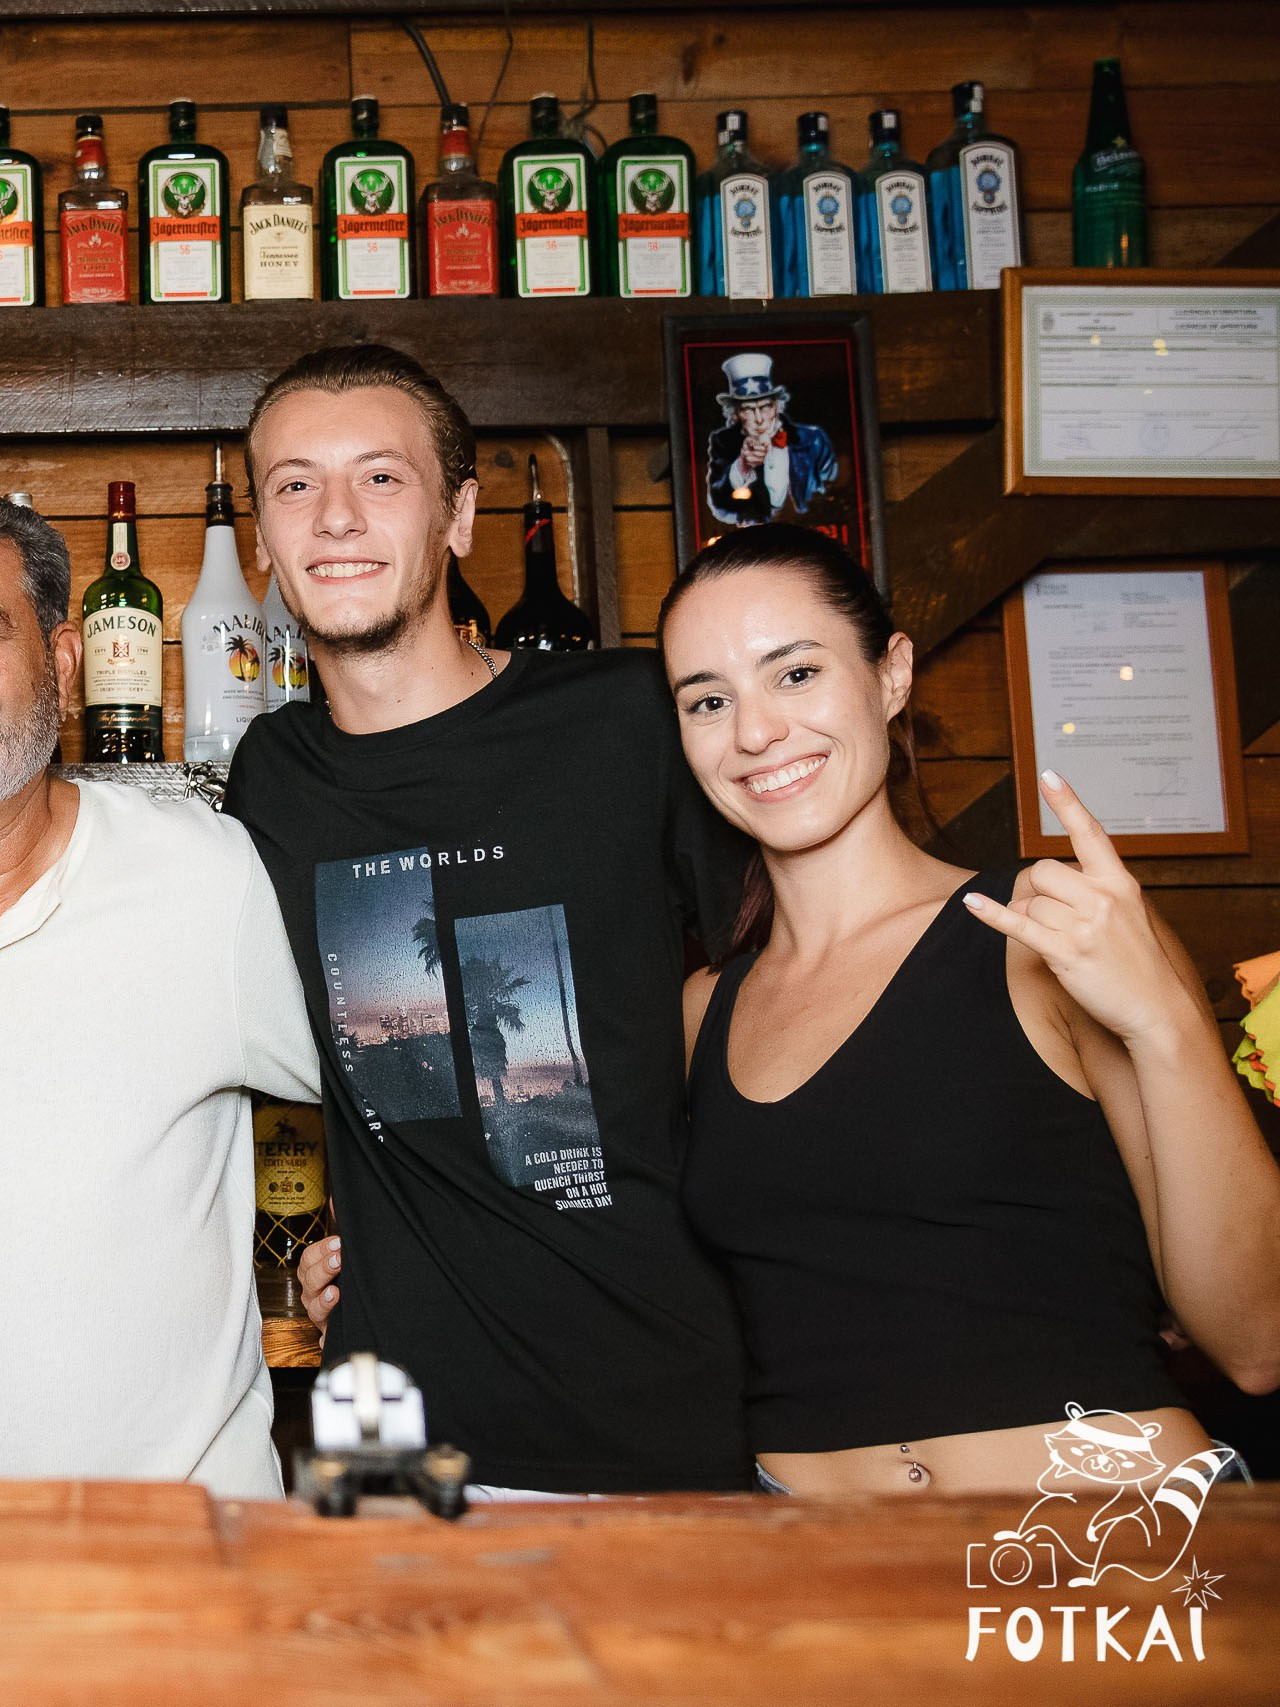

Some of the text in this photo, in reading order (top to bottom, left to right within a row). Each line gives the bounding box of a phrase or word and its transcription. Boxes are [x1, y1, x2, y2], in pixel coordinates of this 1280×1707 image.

[153, 220, 218, 236] Jägermeister
[250, 214, 308, 235] JACK DANIEL'S
[340, 218, 405, 234] Jägermeister
[179, 245, 190, 255] 56
[367, 242, 378, 252] 56
[87, 615, 157, 638] JAMESON
[352, 845, 505, 879] THE WORLDS
[327, 953, 354, 1073] COUNTLESS
[256, 1142, 318, 1156] TERRY
[525, 1147, 602, 1166] A COLD DRINK IS
[553, 1158, 604, 1174] NEEDED TO
[534, 1171, 605, 1192] QUENCH THIRST
[566, 1182, 608, 1199] ON A HOT
[555, 1195, 613, 1211] SUMMER DAY
